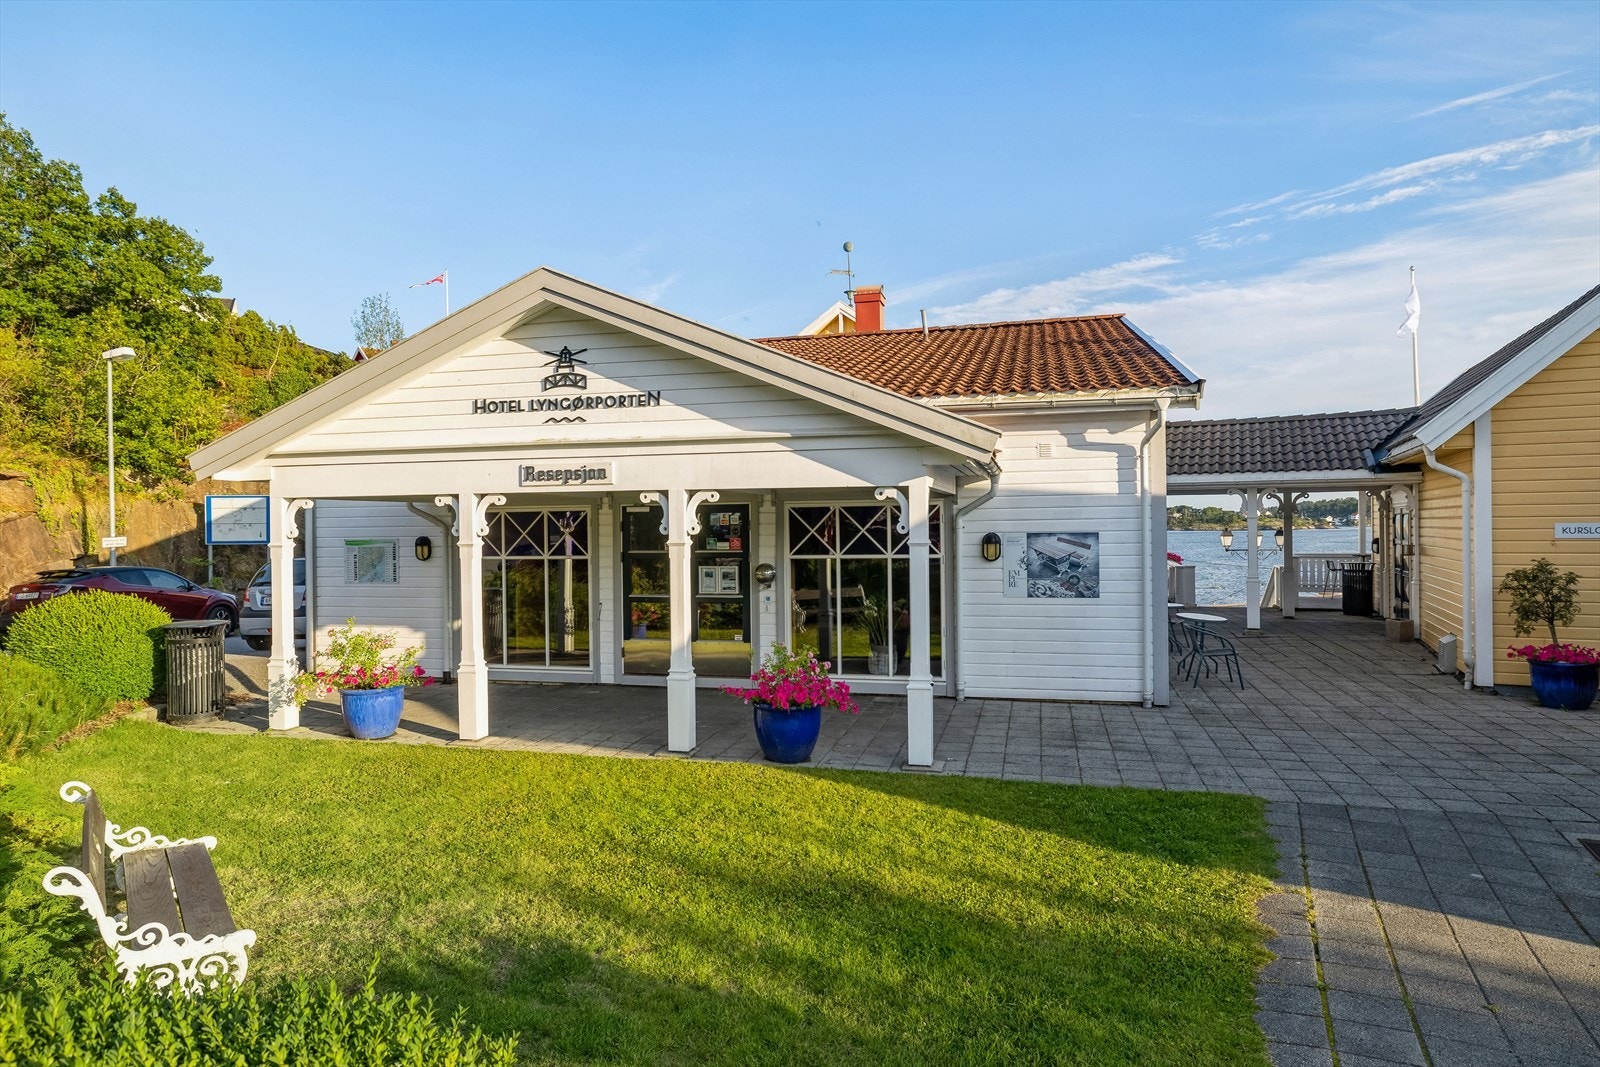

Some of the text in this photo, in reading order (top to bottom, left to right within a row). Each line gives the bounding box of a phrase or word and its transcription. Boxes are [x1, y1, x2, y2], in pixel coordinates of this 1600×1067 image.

[474, 390, 661, 414] HOTEL LYNGØRPORTEN
[523, 465, 607, 484] Resepsjon
